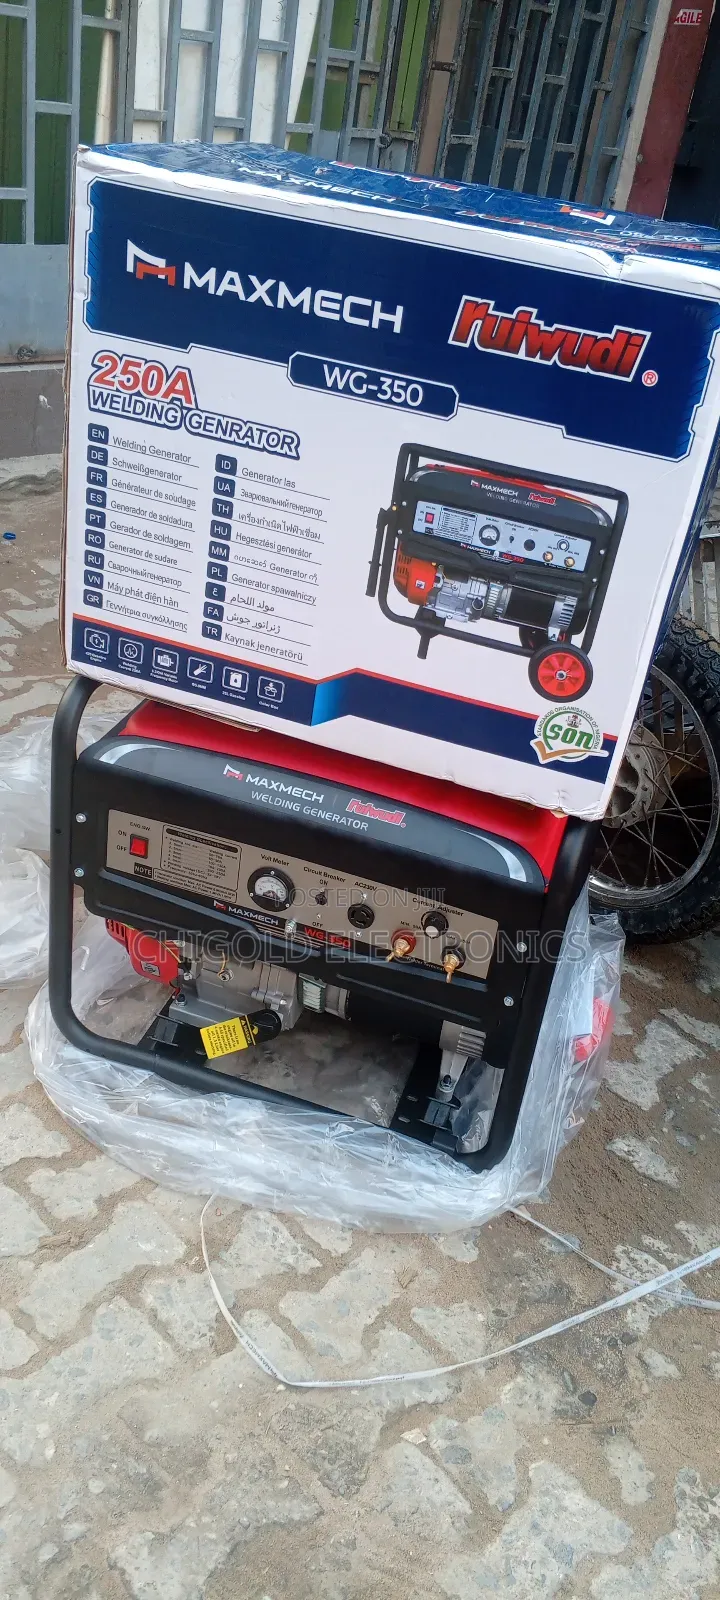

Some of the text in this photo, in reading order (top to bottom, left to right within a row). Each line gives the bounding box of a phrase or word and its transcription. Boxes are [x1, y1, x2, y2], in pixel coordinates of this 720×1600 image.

[674, 11, 702, 24] AGILE
[238, 167, 397, 203] MAXMECH
[183, 261, 404, 334] MAXMECH
[448, 295, 651, 382] ruiwudi
[92, 354, 194, 406] 250A
[322, 363, 423, 407] WG-350
[91, 389, 298, 456] WELDING GENRATOR
[91, 428, 105, 440] EN
[91, 450, 104, 461] DE
[112, 435, 192, 463] Welding Generator
[112, 457, 183, 482] Schweißgenerator
[221, 460, 231, 470] ID
[90, 471, 103, 482] FR
[241, 467, 296, 489] Generator las
[111, 478, 196, 508] Générateur de soudage
[217, 481, 231, 492] UA
[481, 483, 519, 497] MAXMECH
[90, 492, 103, 503] ES
[110, 500, 193, 529] Generador de soldadura
[216, 503, 230, 514] TH
[89, 513, 102, 524] PT
[109, 520, 191, 549] Gerador de soldagem
[214, 525, 228, 536] HU
[88, 533, 102, 545] RO
[235, 531, 312, 559] Hegesztési generátor
[108, 540, 178, 566] Generator de sudare
[211, 545, 227, 557] MM
[87, 554, 101, 565] RU
[211, 566, 223, 577] PL
[269, 562, 308, 580] Generator
[87, 574, 100, 585] VN
[107, 581, 124, 594] Máy
[124, 586, 144, 600] phát
[163, 594, 179, 608] hàn
[231, 573, 317, 605] Generator spawalniczy
[86, 594, 100, 604] GR
[207, 606, 220, 617] FA
[205, 626, 218, 636] TR
[224, 632, 303, 661] Kaynak jeneratörü
[245, 773, 325, 804] MAXMECH
[251, 790, 369, 832] WELDING GENERATOR
[117, 829, 127, 837] ON
[116, 844, 127, 852] OFF
[260, 853, 290, 867] Volt Meter
[134, 866, 152, 876] NOTE
[303, 866, 346, 883] Circuit Breaker
[228, 906, 279, 926] MAXMECH
[304, 926, 351, 949] WG-350
